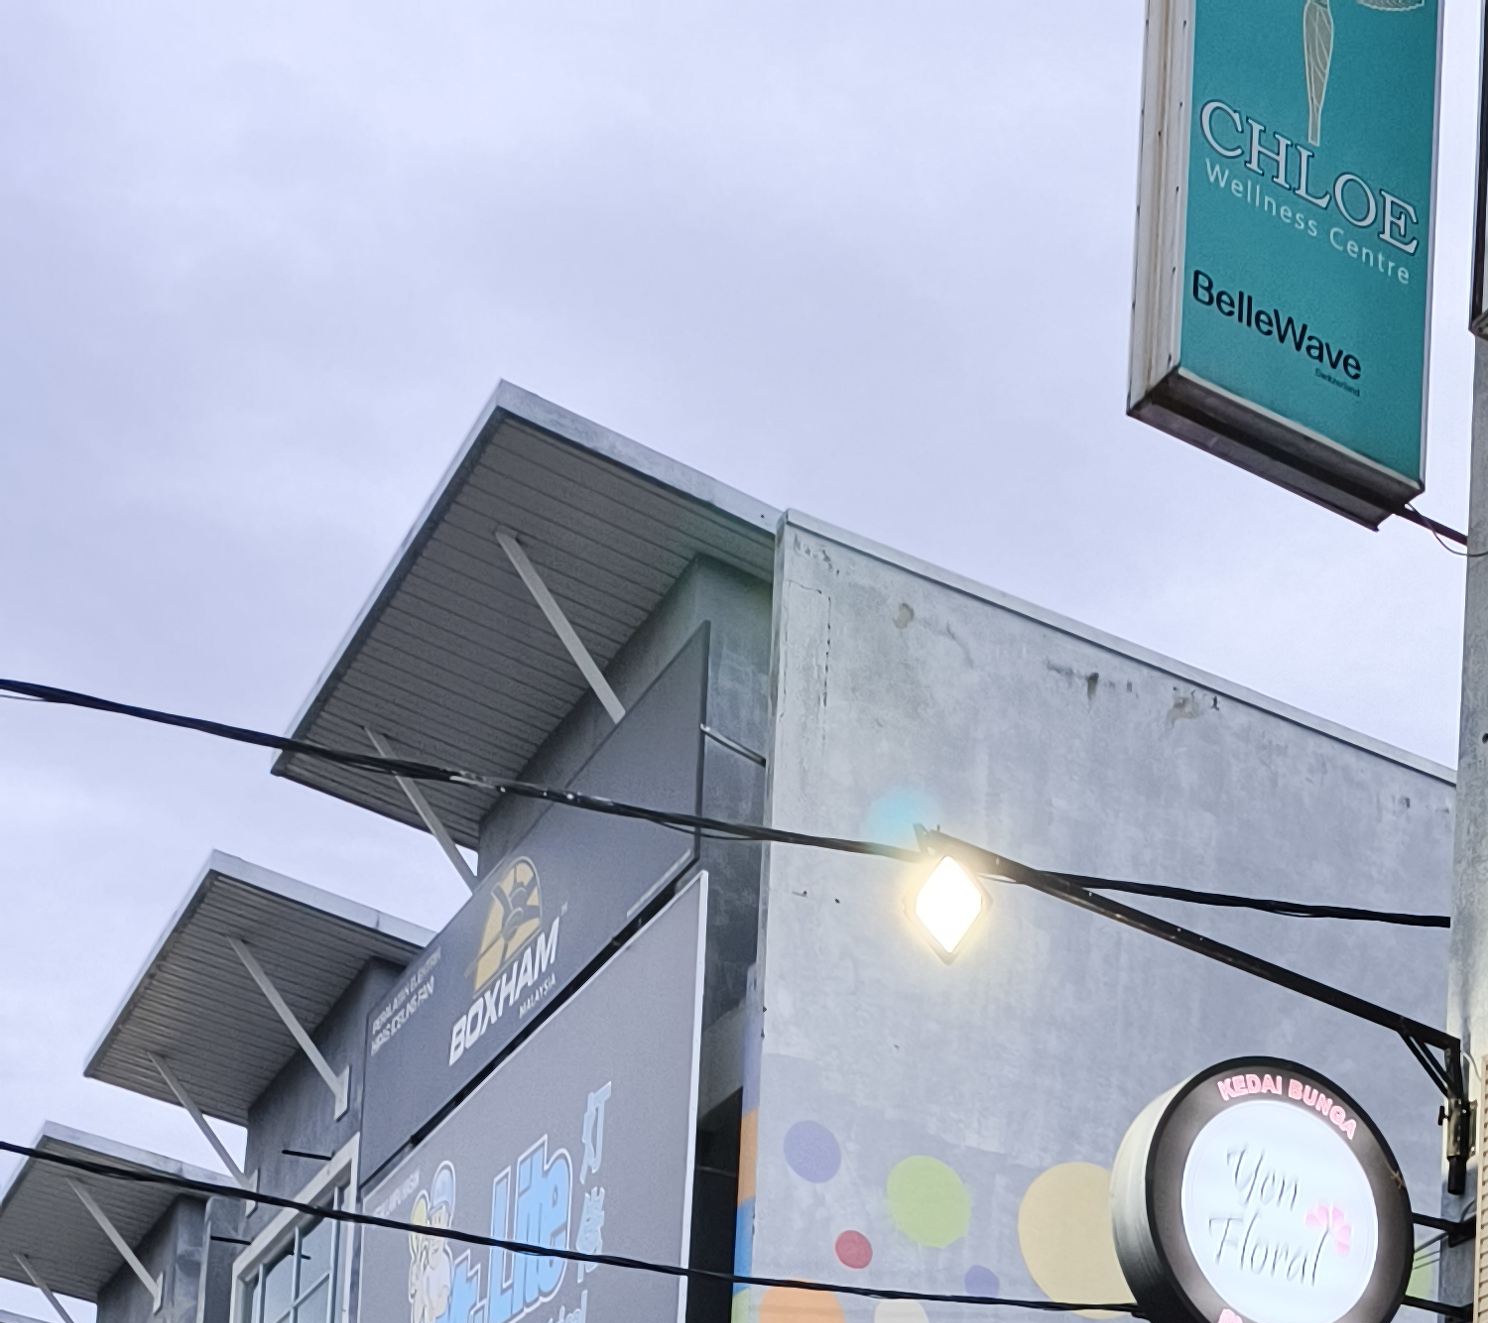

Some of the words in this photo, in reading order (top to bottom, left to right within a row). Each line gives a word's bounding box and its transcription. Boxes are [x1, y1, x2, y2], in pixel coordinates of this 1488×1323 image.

[1200, 100, 1420, 255] CHLOE
[1205, 157, 1318, 237] Wellness
[1329, 227, 1410, 285] Centre
[1193, 269, 1362, 381] BelleWave
[449, 916, 560, 1066] BOXHAM
[1217, 1073, 1283, 1101] KEDAI
[1288, 1078, 1357, 1140] BUNGA
[1207, 1210, 1331, 1287] Floral
